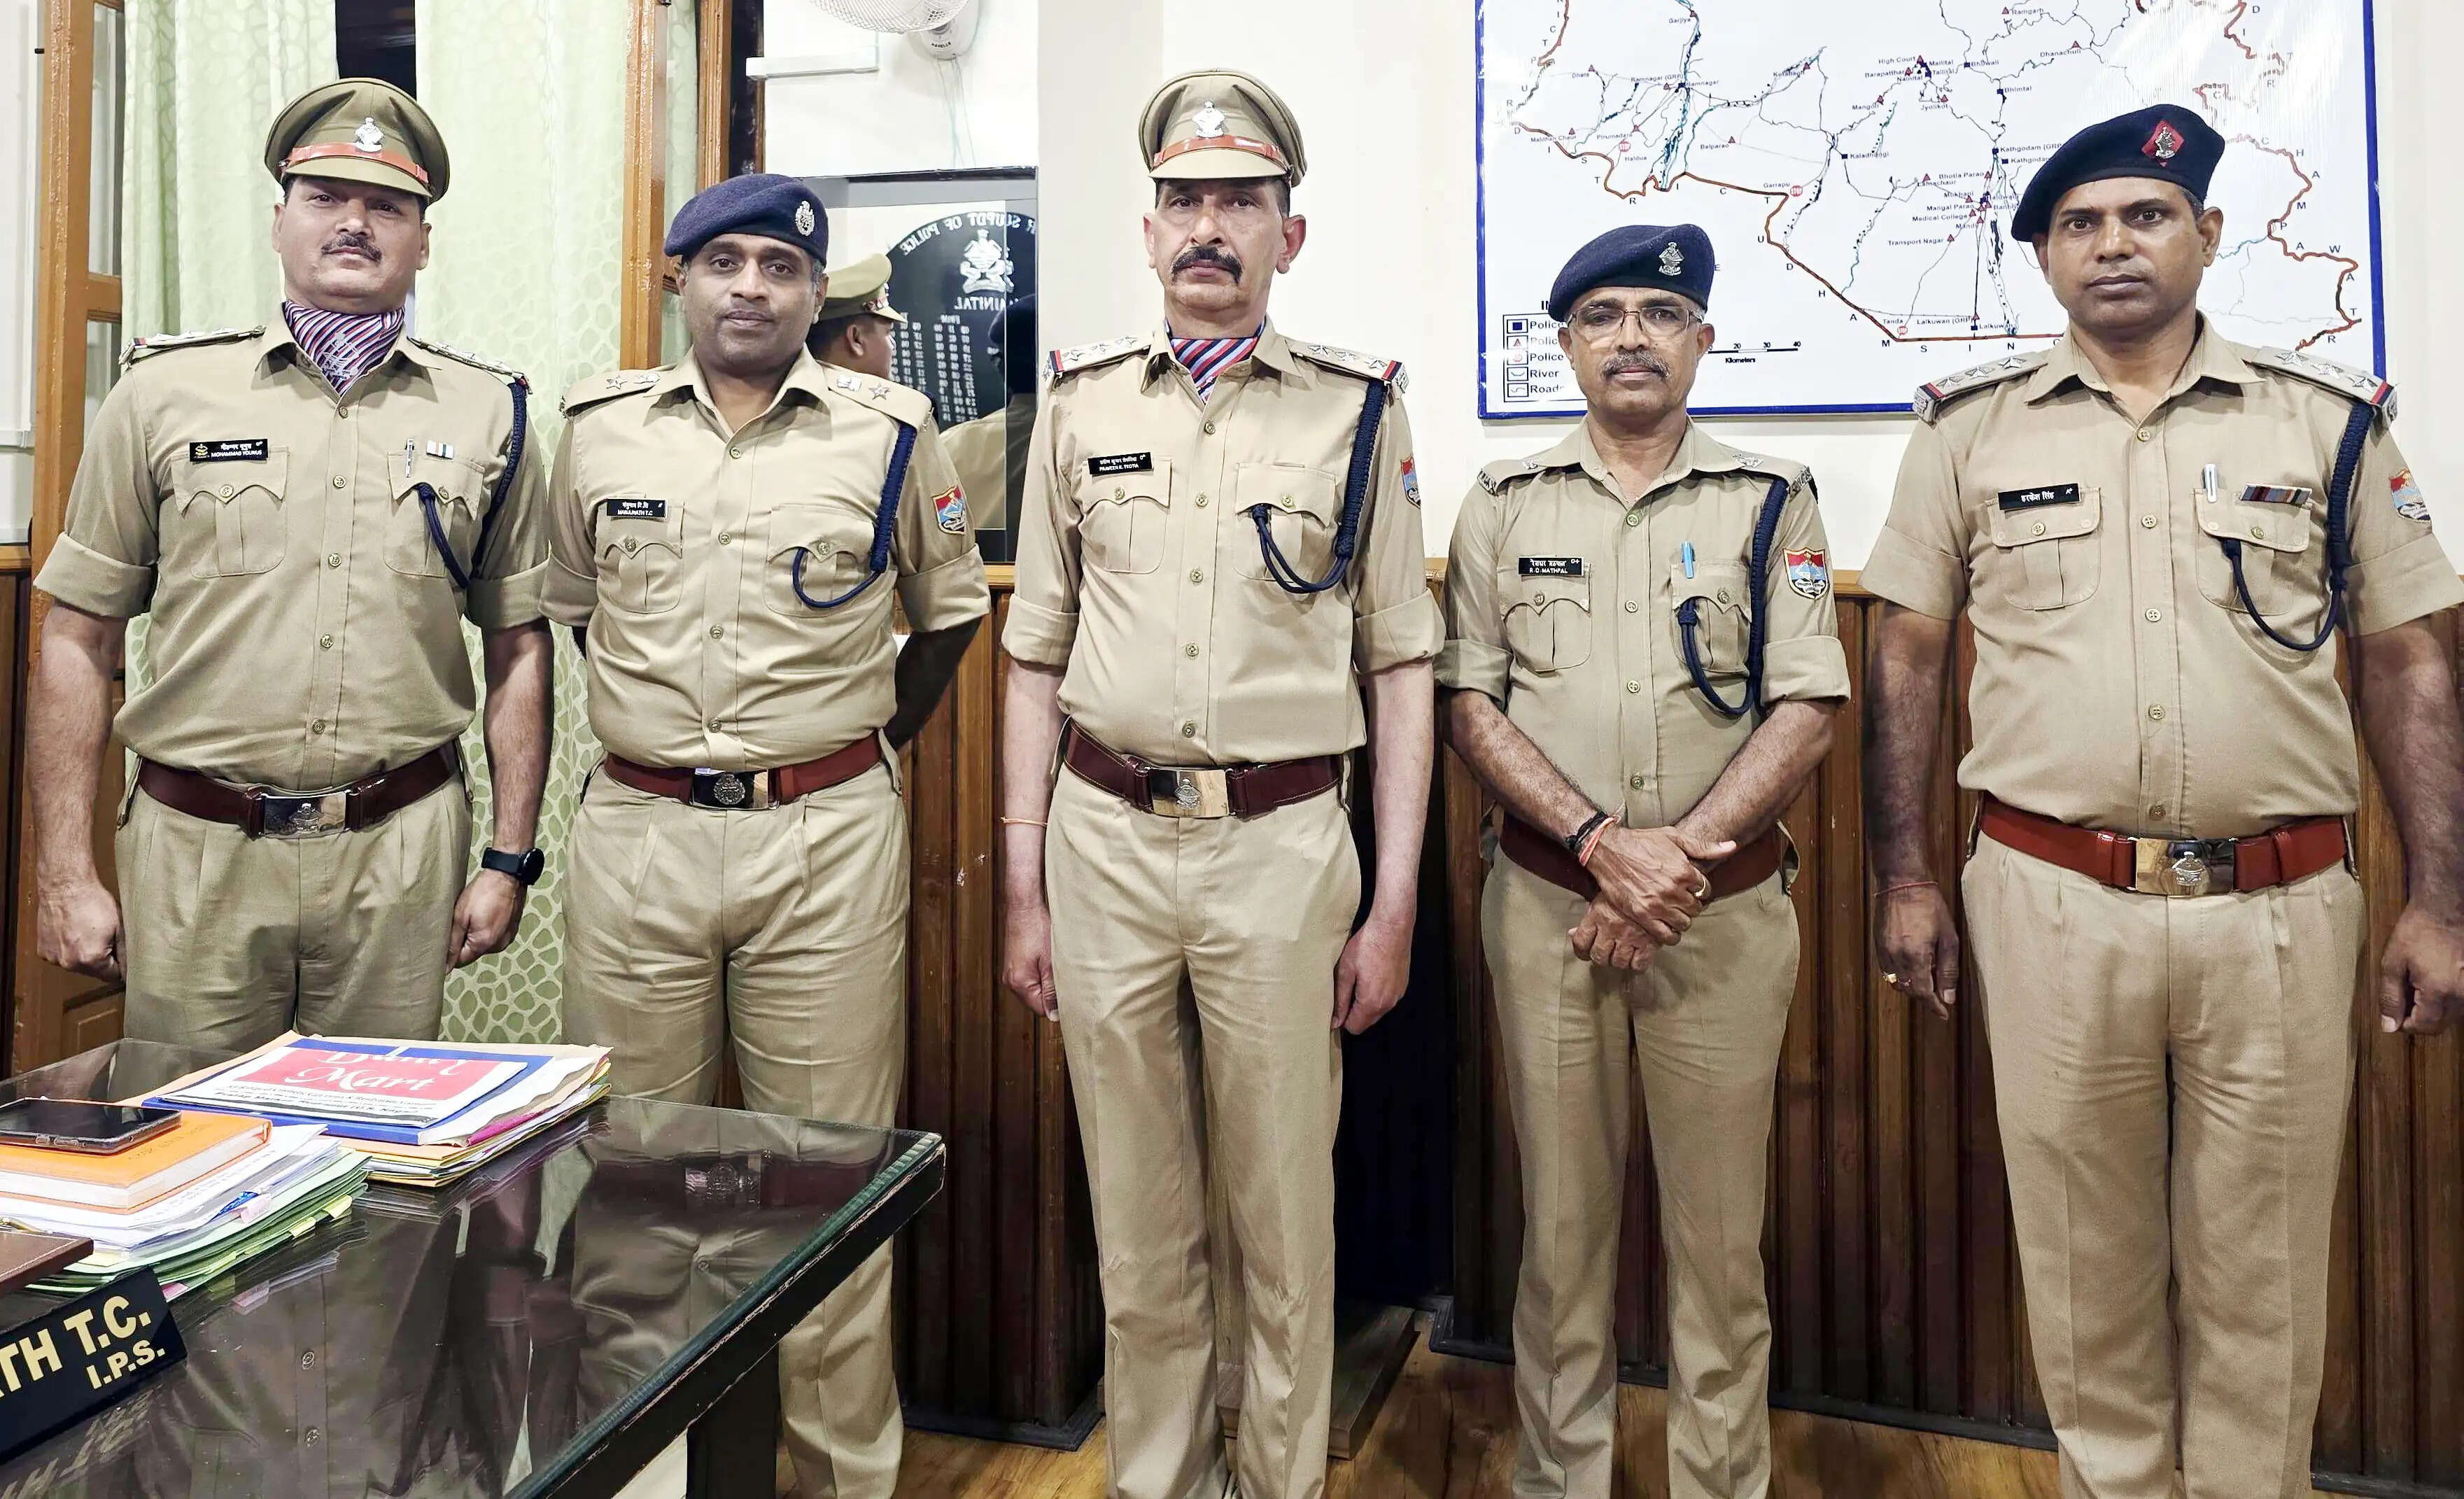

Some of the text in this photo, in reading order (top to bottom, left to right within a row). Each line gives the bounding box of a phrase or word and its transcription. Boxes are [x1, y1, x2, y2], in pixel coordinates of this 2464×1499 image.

[2040, 48, 2081, 57] Dhanachuli
[1530, 337, 1558, 346] Polic
[1530, 353, 1564, 361] Police
[1530, 369, 1560, 378] River
[1530, 384, 1565, 393] Road
[284, 1066, 436, 1090] Mart
[0, 1295, 152, 1398] TH T.C.
[85, 1339, 166, 1390] I.P.S.
